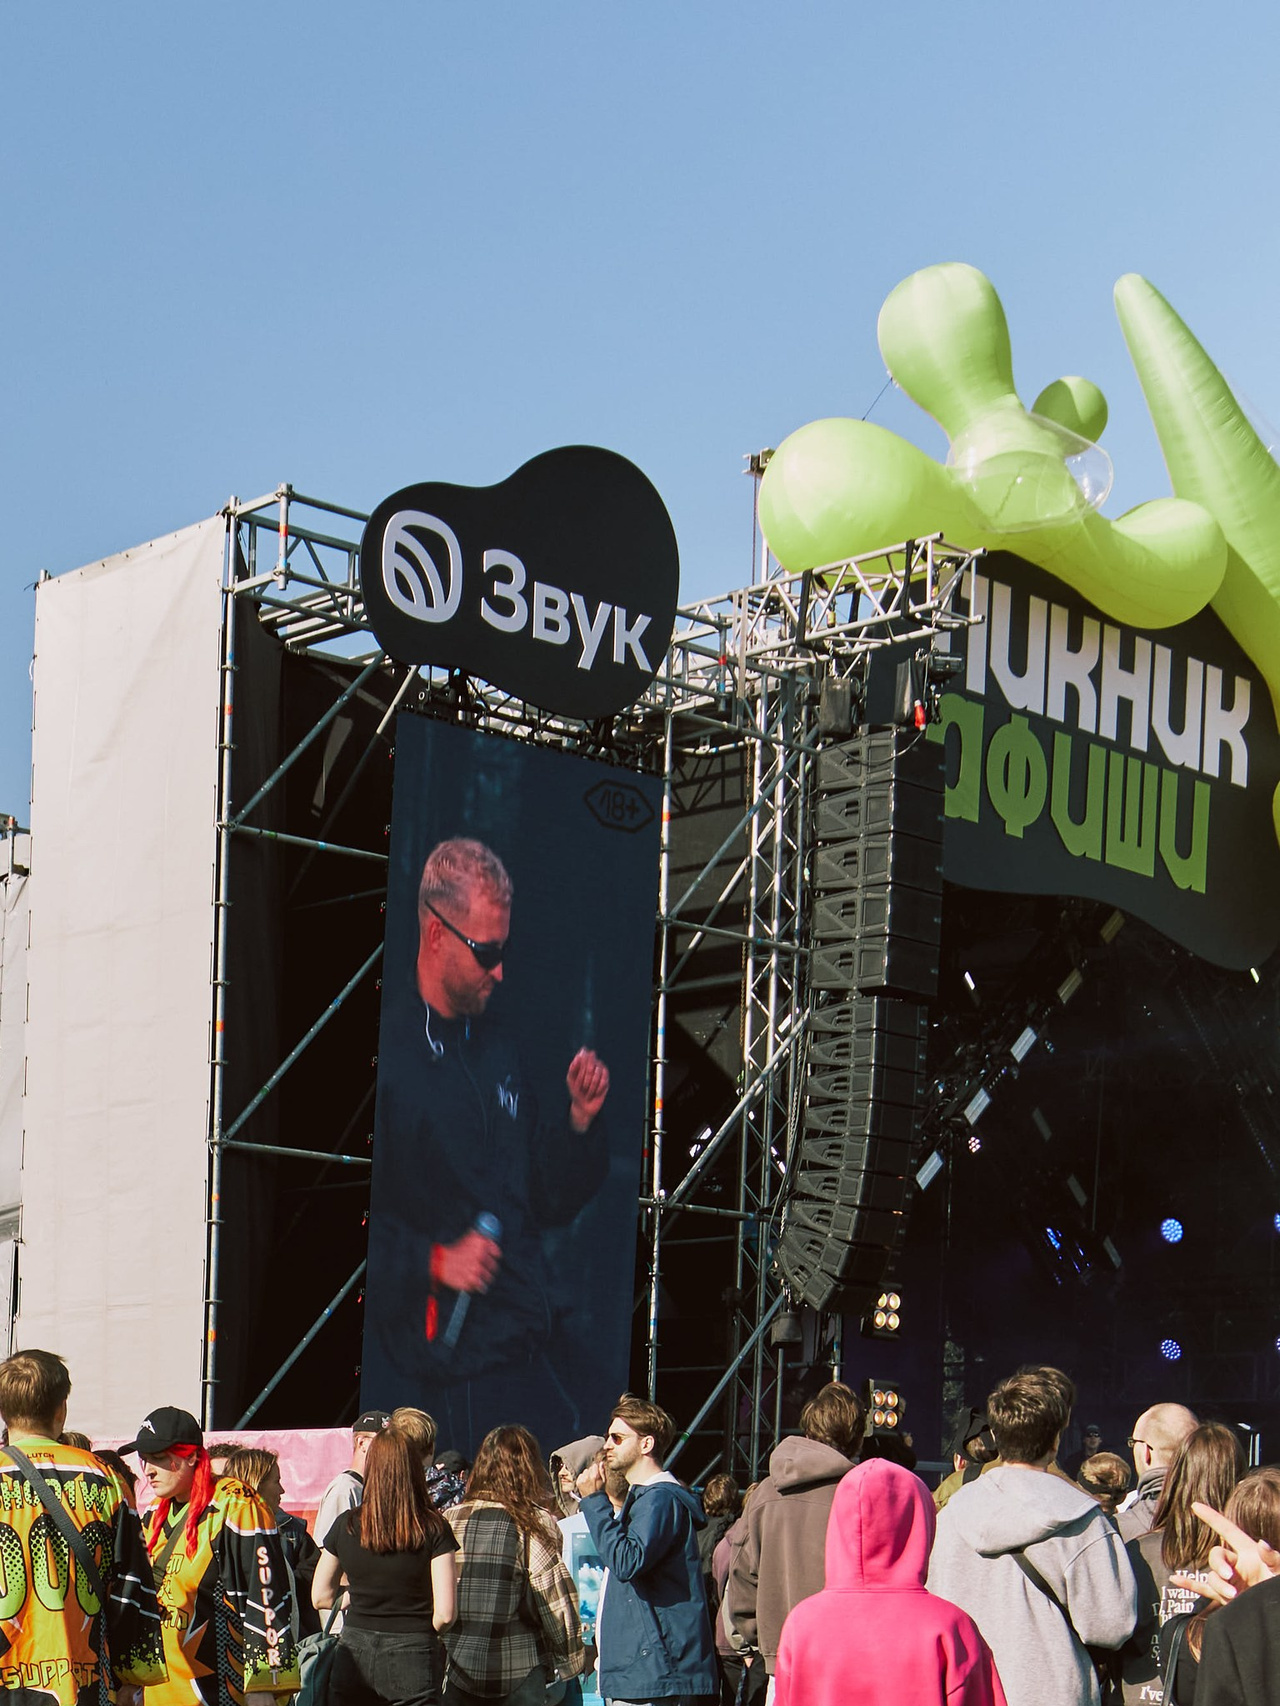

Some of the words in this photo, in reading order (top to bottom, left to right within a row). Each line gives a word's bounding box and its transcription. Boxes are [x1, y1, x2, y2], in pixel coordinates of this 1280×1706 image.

[481, 549, 652, 671] Звук
[599, 789, 640, 821] 18+
[257, 1546, 281, 1685] SUPPORT
[1140, 1686, 1163, 1701] I've
